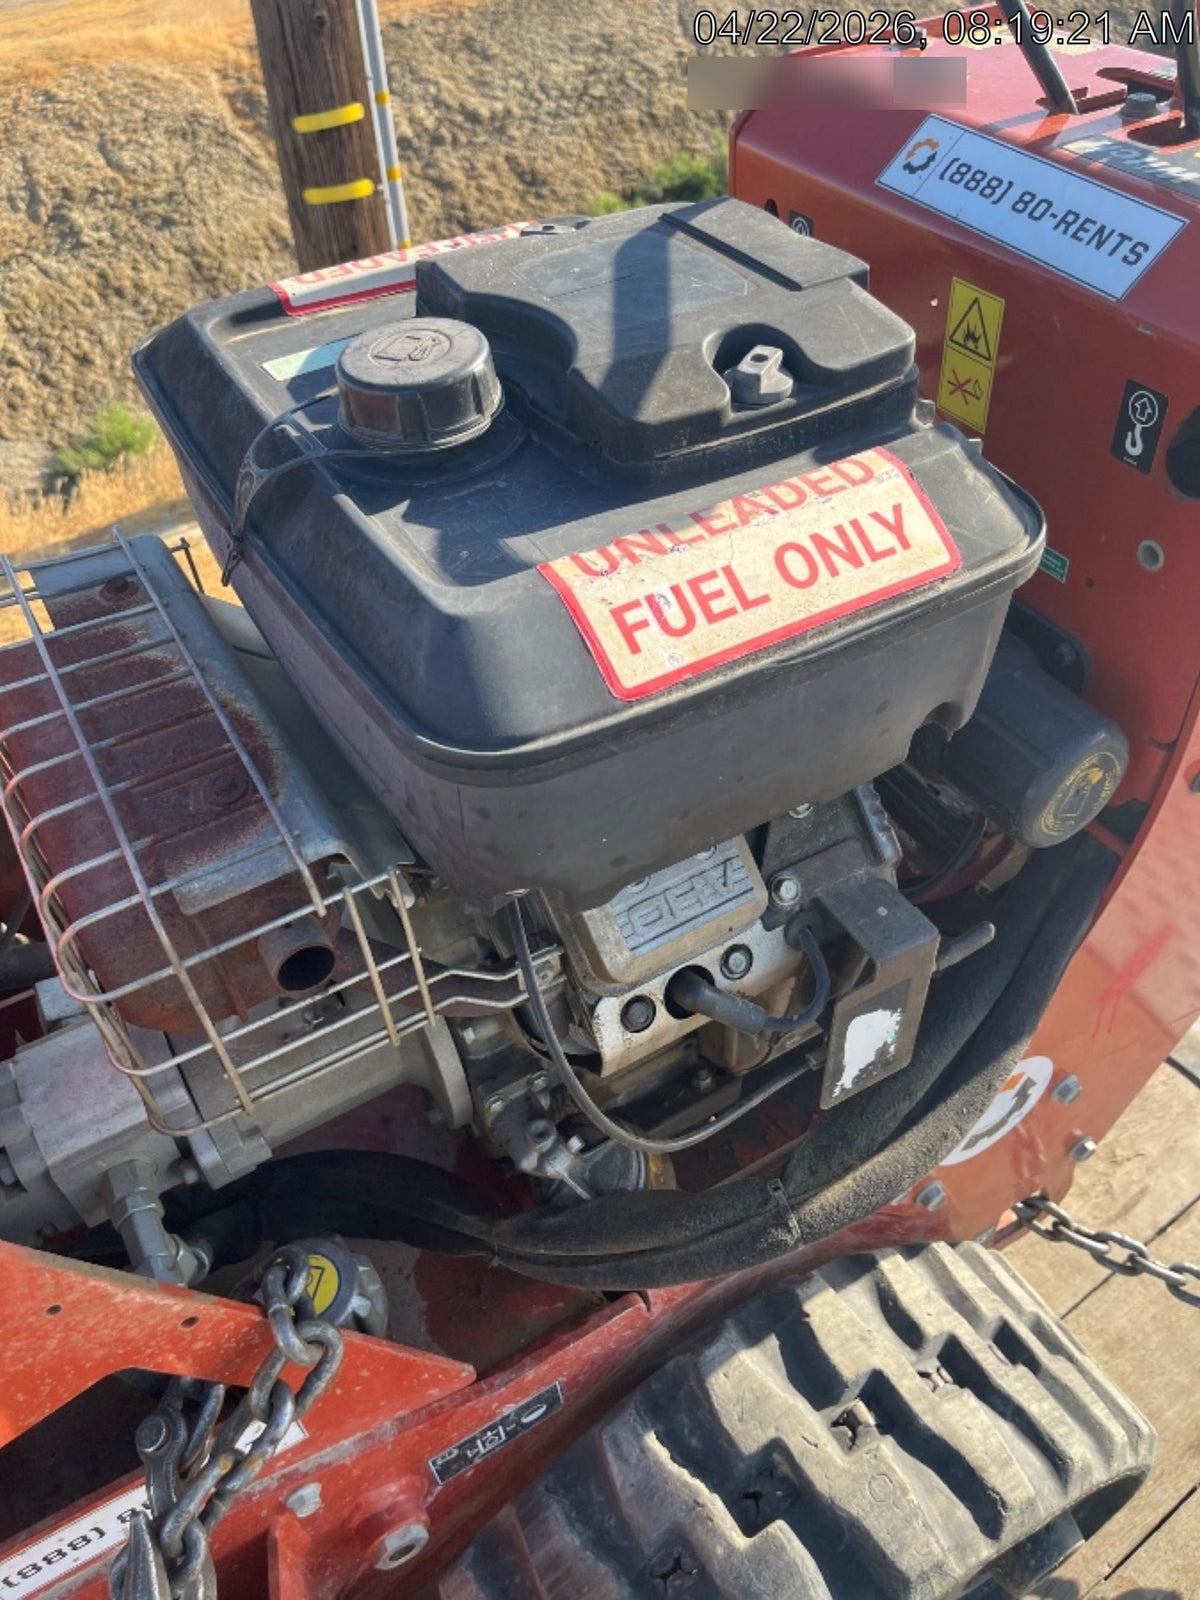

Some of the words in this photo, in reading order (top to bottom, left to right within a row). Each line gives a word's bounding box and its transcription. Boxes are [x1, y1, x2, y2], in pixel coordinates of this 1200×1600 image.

[938, 158, 1014, 205] (888)
[1011, 191, 1150, 267] 80-RENTS
[570, 457, 875, 578] UNLEADED
[610, 564, 771, 656] FUEL
[774, 503, 913, 590] ONLY
[1, 1526, 107, 1588] (888)
